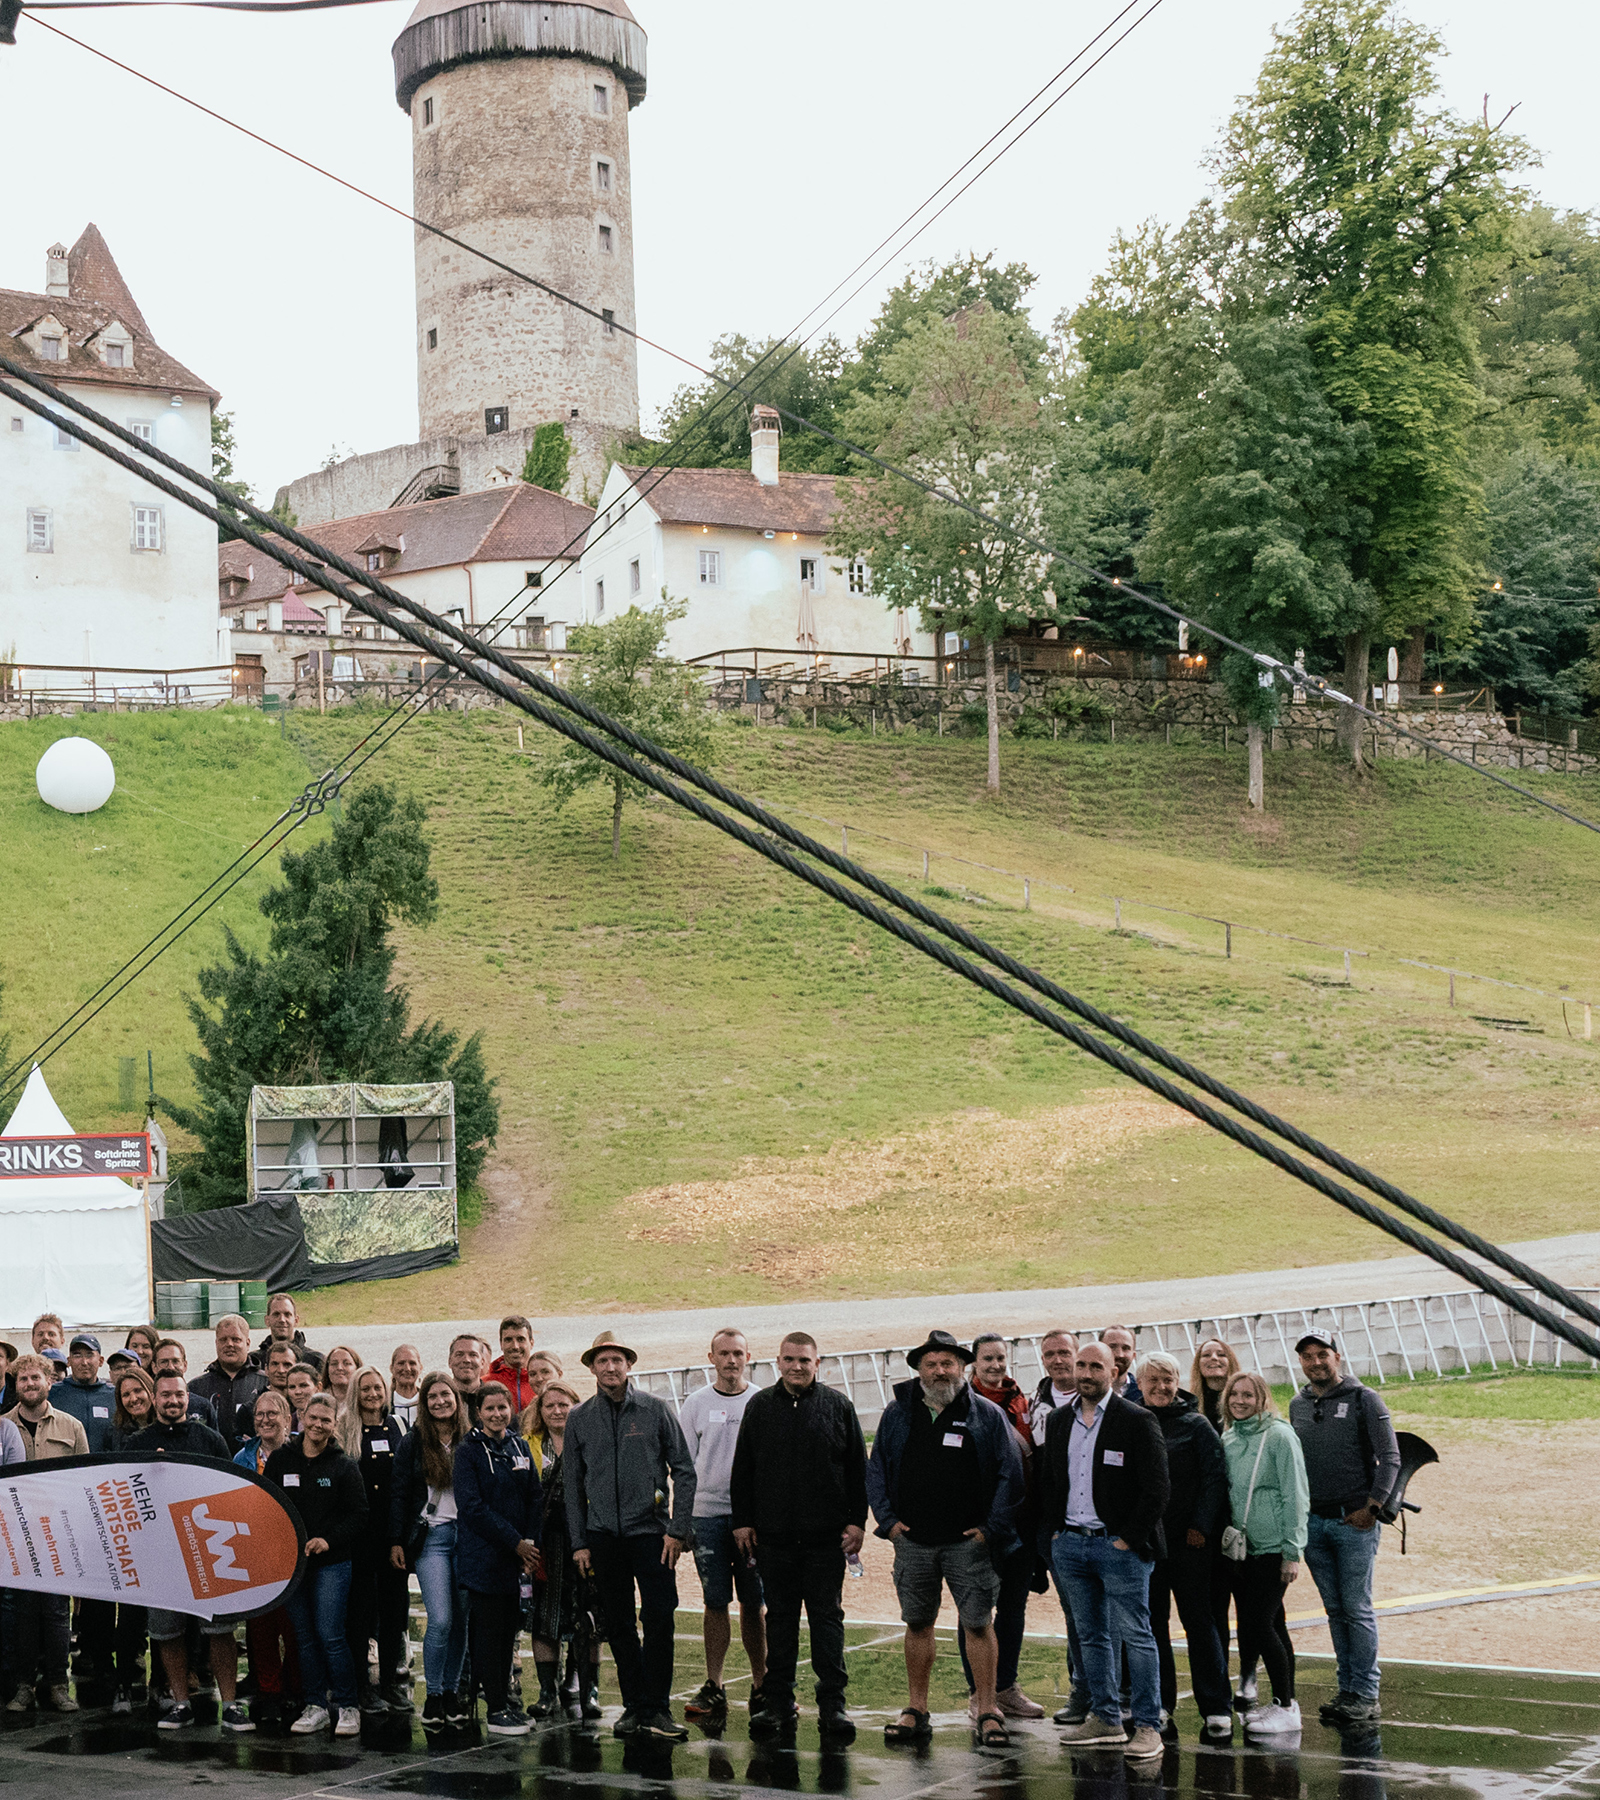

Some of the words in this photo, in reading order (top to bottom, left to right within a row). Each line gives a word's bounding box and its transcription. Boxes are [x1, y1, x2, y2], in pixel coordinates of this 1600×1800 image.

[94, 1149, 141, 1160] Softdrinks
[104, 1158, 141, 1169] Spritzer
[121, 1140, 140, 1149] Bier
[112, 1479, 142, 1533] JUNGE
[129, 1473, 157, 1522] MEHR
[8, 1487, 43, 1578] #mehrchancenseher
[39, 1515, 65, 1577] #mehrmut
[59, 1509, 86, 1578] #mehrnetzwerk
[96, 1480, 141, 1588] WIRTSCHAFT
[181, 1515, 210, 1593] OBERÖSTERREICH
